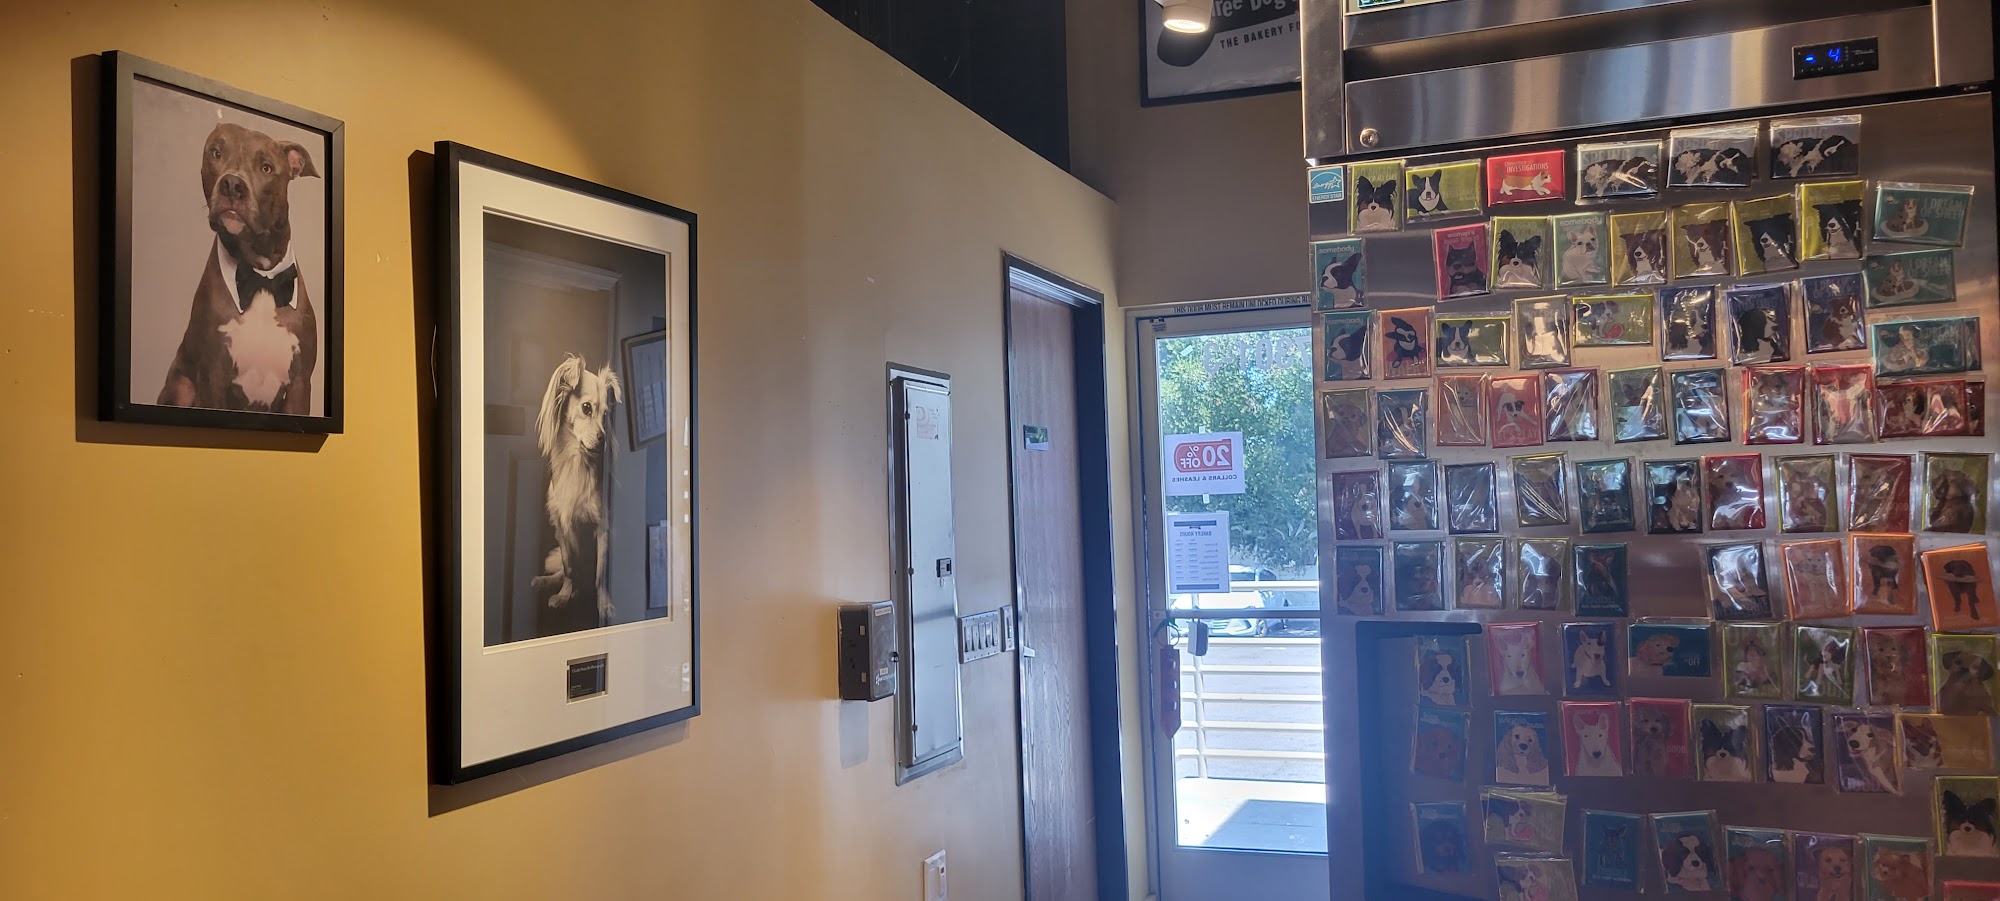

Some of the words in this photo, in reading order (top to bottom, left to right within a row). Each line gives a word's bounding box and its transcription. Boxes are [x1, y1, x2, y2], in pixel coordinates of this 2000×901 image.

[1220, 36, 1239, 49] THE
[1243, 26, 1283, 44] BAKERY
[1828, 48, 1840, 62] 4
[1506, 162, 1549, 173] INVESTIGATIONS
[1560, 216, 1603, 226] somebody
[1319, 245, 1355, 254] somebody
[1174, 306, 1186, 314] THIS
[1205, 303, 1221, 312] MUST
[1222, 301, 1245, 310] REMAIN
